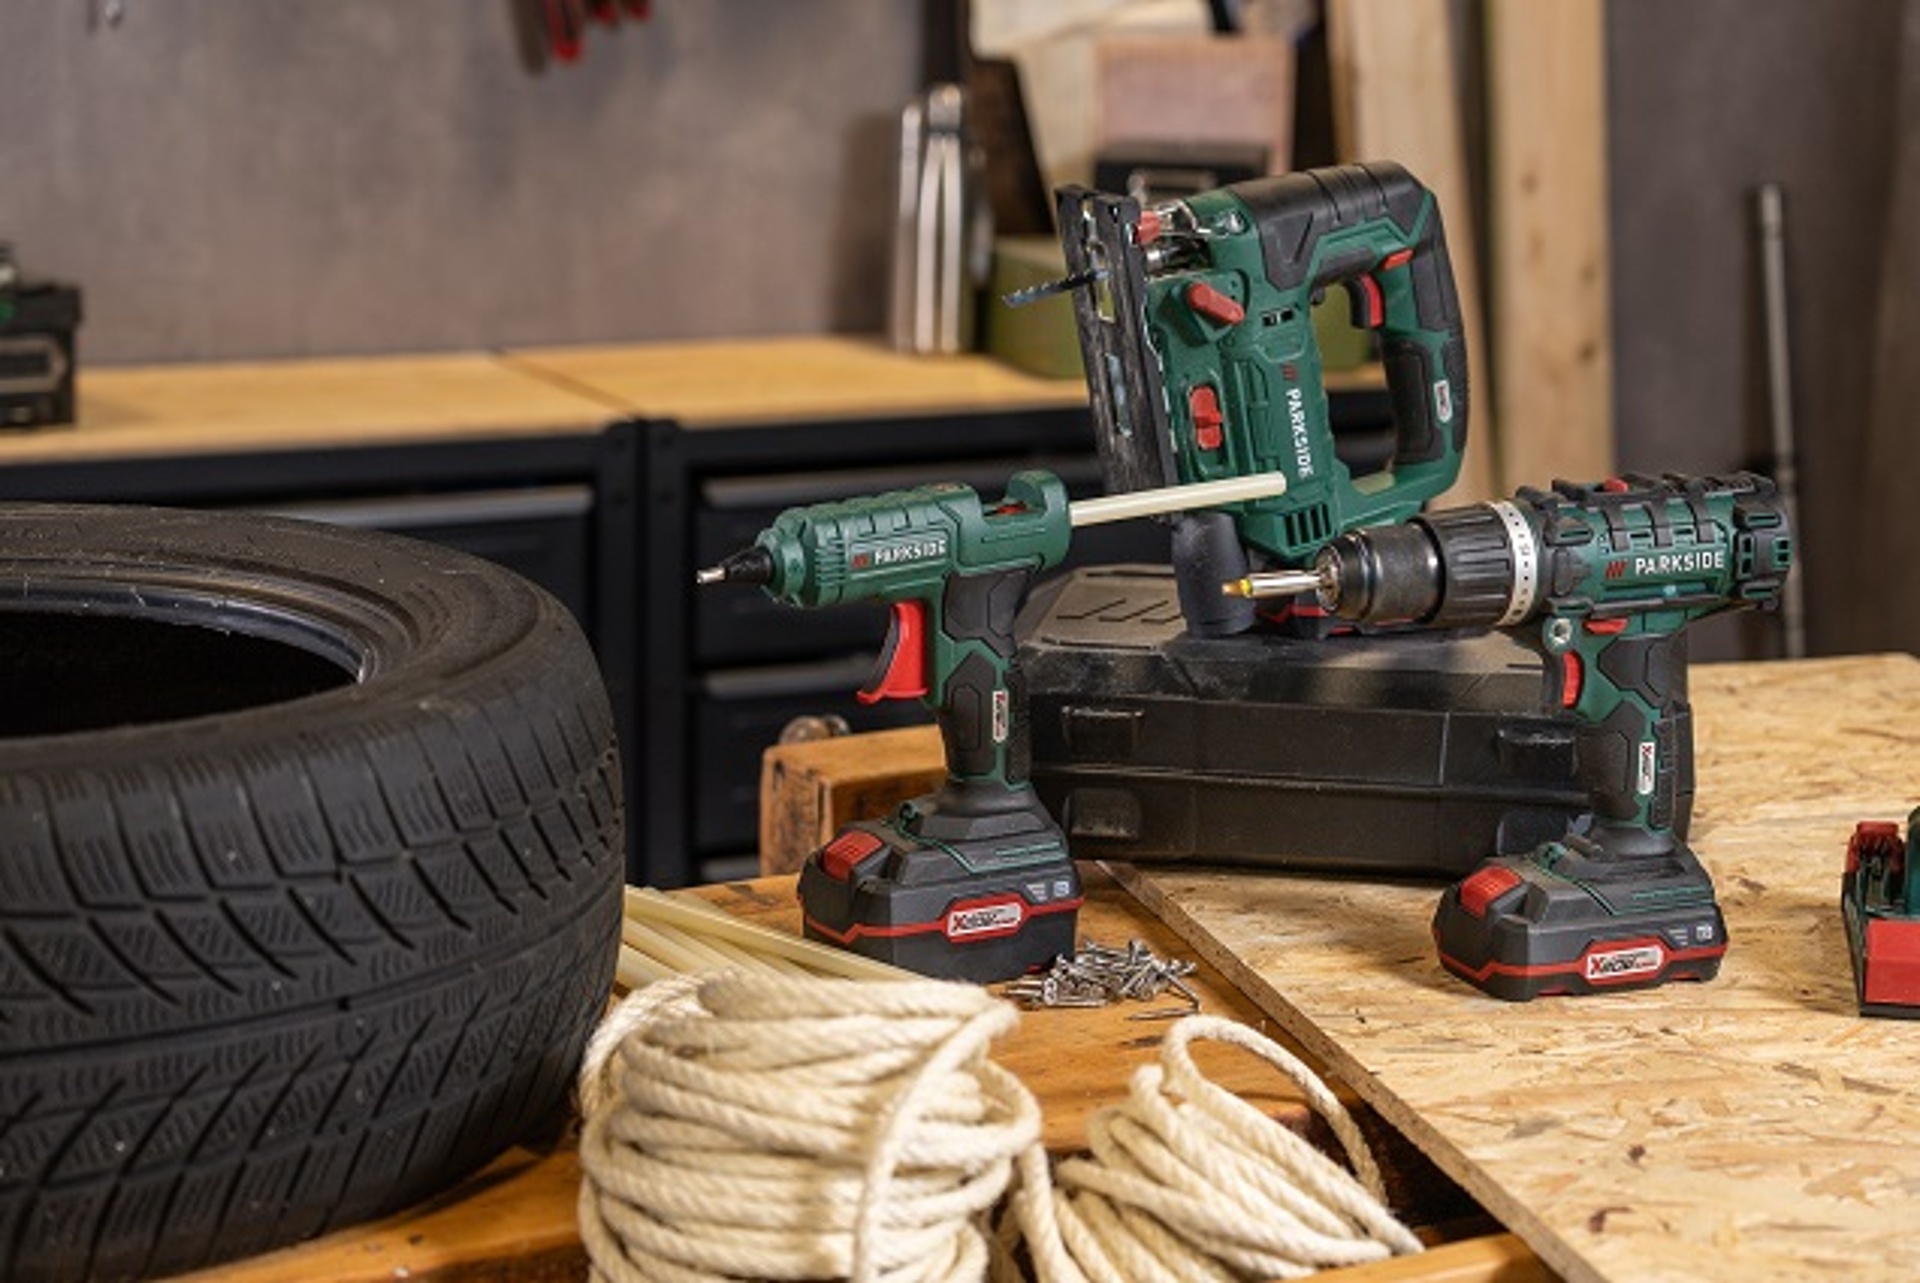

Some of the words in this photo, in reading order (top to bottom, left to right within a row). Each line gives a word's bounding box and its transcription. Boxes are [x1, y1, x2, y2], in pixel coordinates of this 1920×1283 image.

[1285, 388, 1314, 479] PARKSIDE
[874, 540, 946, 566] PARKSIDE
[1635, 550, 1725, 576] PARKSIDE
